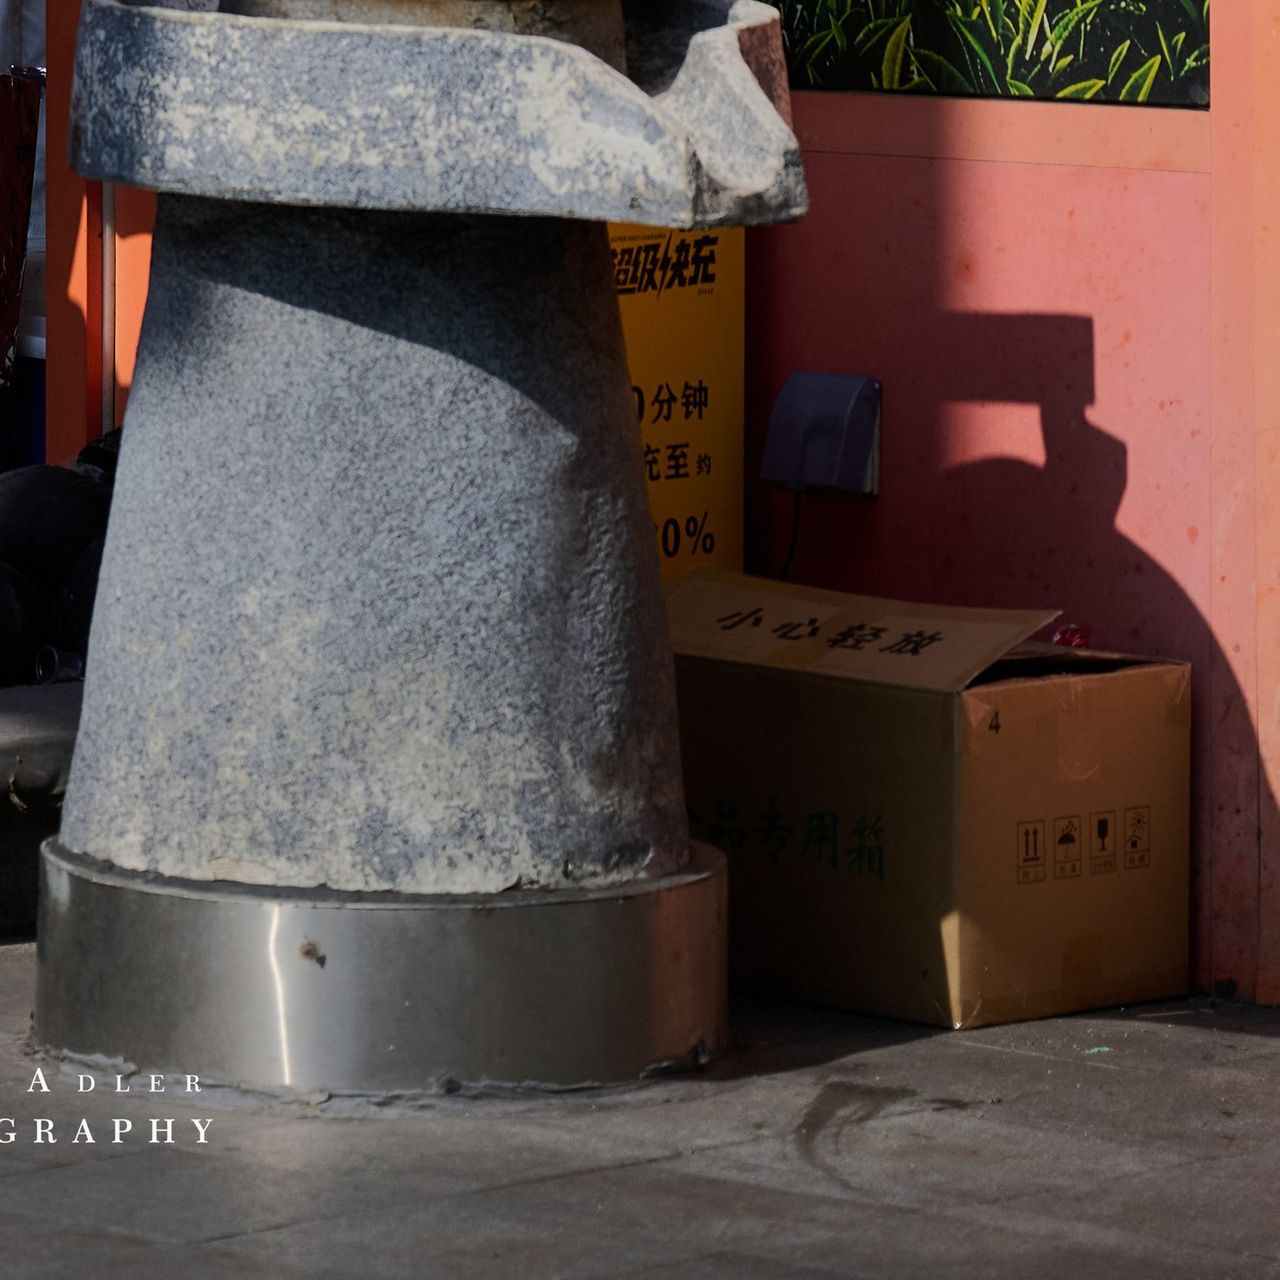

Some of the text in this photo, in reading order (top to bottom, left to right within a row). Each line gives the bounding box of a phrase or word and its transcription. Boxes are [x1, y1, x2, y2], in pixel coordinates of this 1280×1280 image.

[717, 607, 944, 657] 小心轻放
[988, 709, 1001, 735] 4
